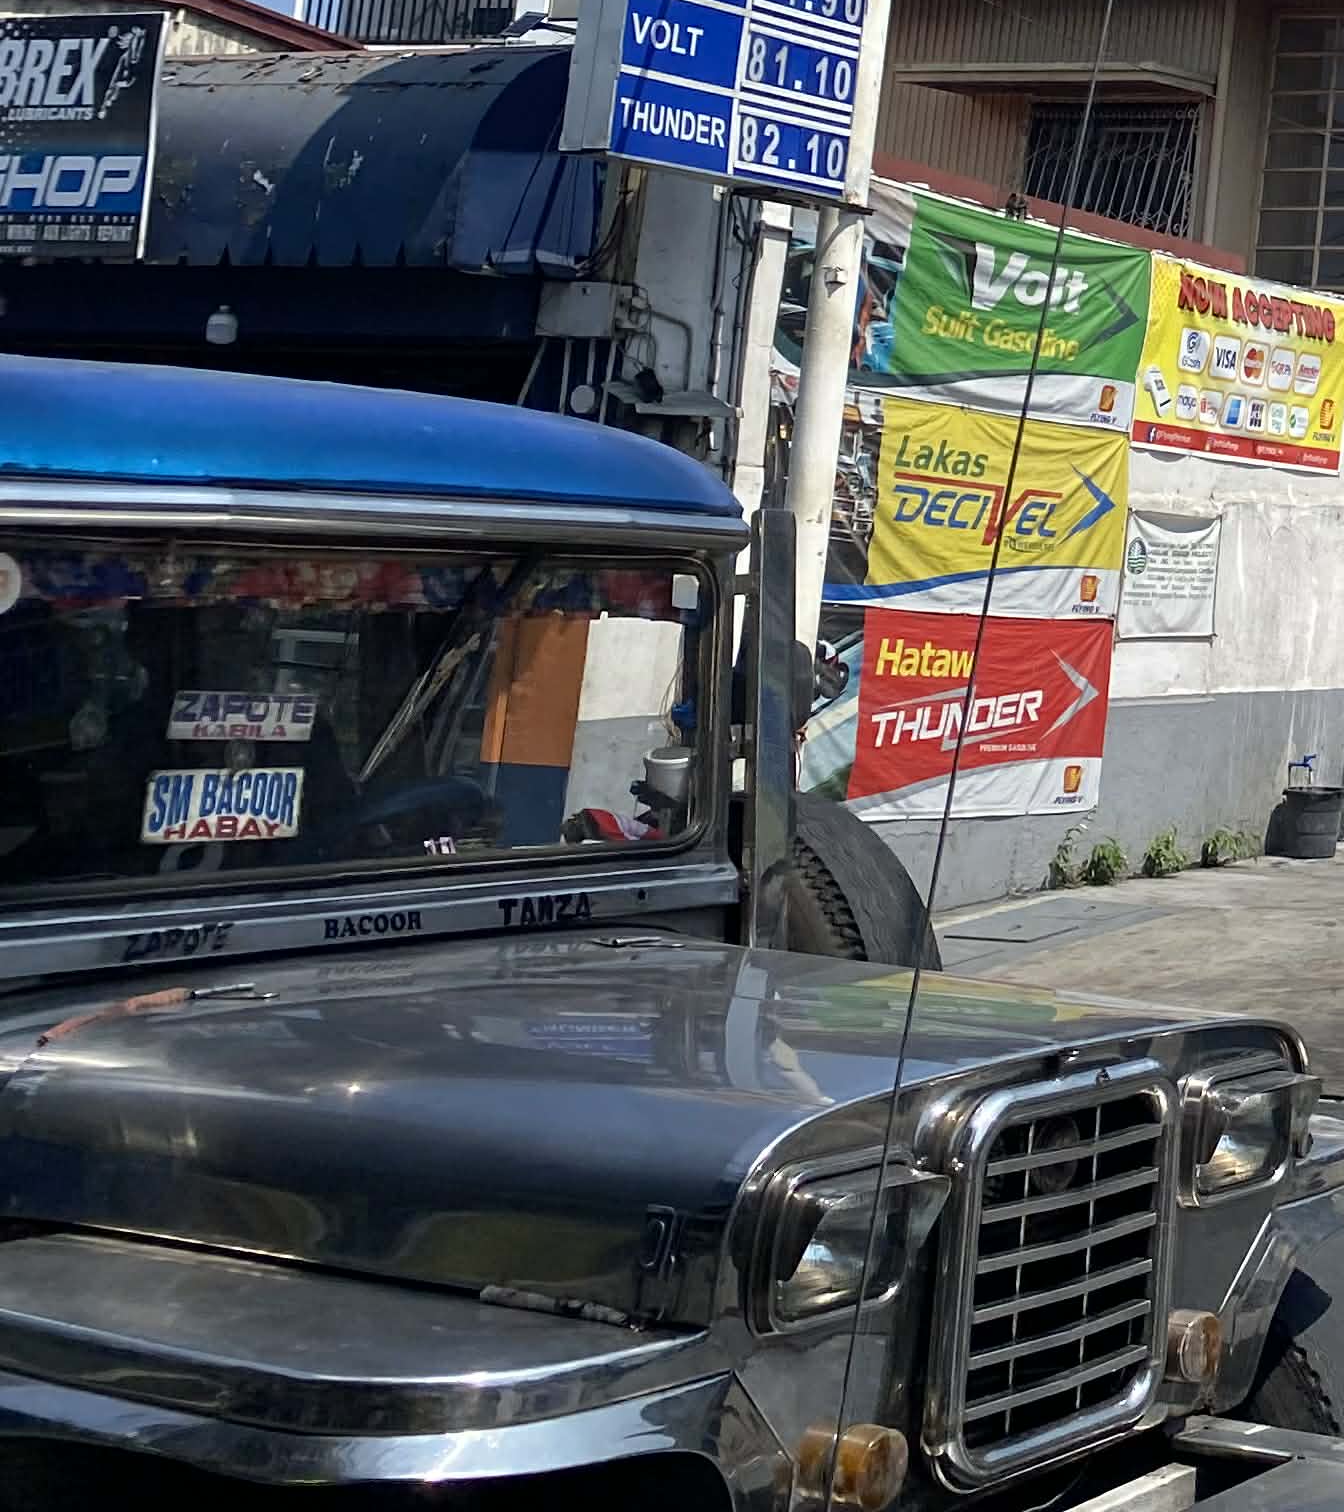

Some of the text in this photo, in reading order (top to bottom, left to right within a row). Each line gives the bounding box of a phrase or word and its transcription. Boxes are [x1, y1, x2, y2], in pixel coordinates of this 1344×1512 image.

[632, 13, 851, 101] VOLT 81.10
[620, 96, 844, 178] THUNDER 82.10
[0, 155, 142, 207] HOP
[971, 242, 1089, 315] Volt
[922, 304, 1080, 362] Sulit Gasoline
[1177, 270, 1336, 344] NOW ACCEPTING
[1215, 346, 1237, 371] VISA
[894, 434, 989, 478] Lakas
[892, 483, 1063, 546] DECIVEL
[875, 637, 975, 679] Hataw
[170, 694, 316, 724] ZAPOTE
[871, 689, 1044, 748] THUNDER
[151, 771, 298, 834] SM BACOOR
[163, 815, 283, 840] HABAY
[323, 911, 423, 939] BACOOR
[498, 891, 594, 927] TANZA
[122, 921, 235, 962] ZAPOTE
